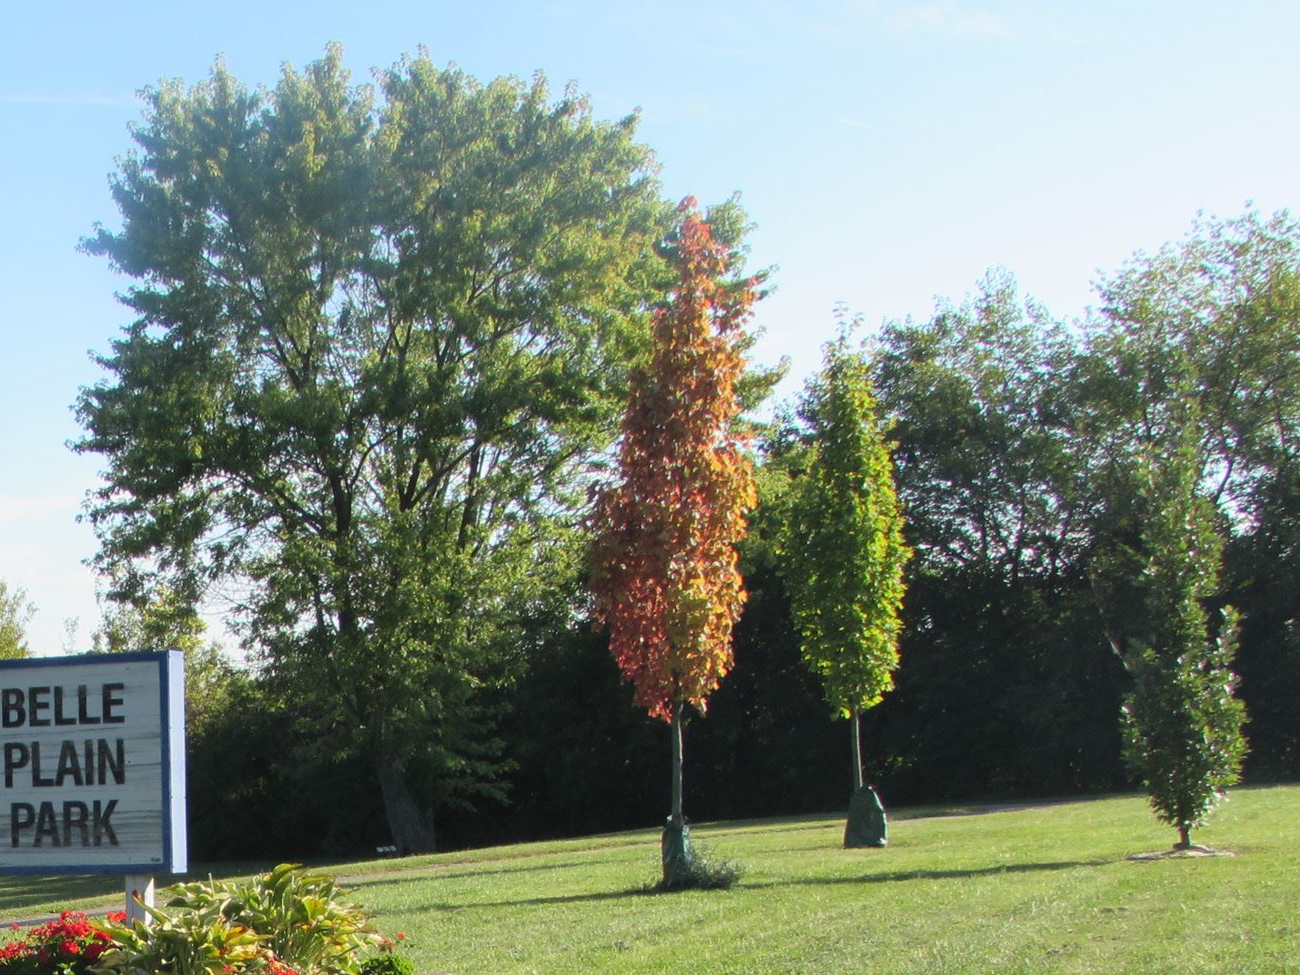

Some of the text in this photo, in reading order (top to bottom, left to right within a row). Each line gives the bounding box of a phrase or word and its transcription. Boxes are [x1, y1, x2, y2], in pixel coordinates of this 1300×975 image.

[1, 682, 125, 728] BELLE
[3, 738, 126, 788] PLAIN
[10, 799, 119, 848] PARK
